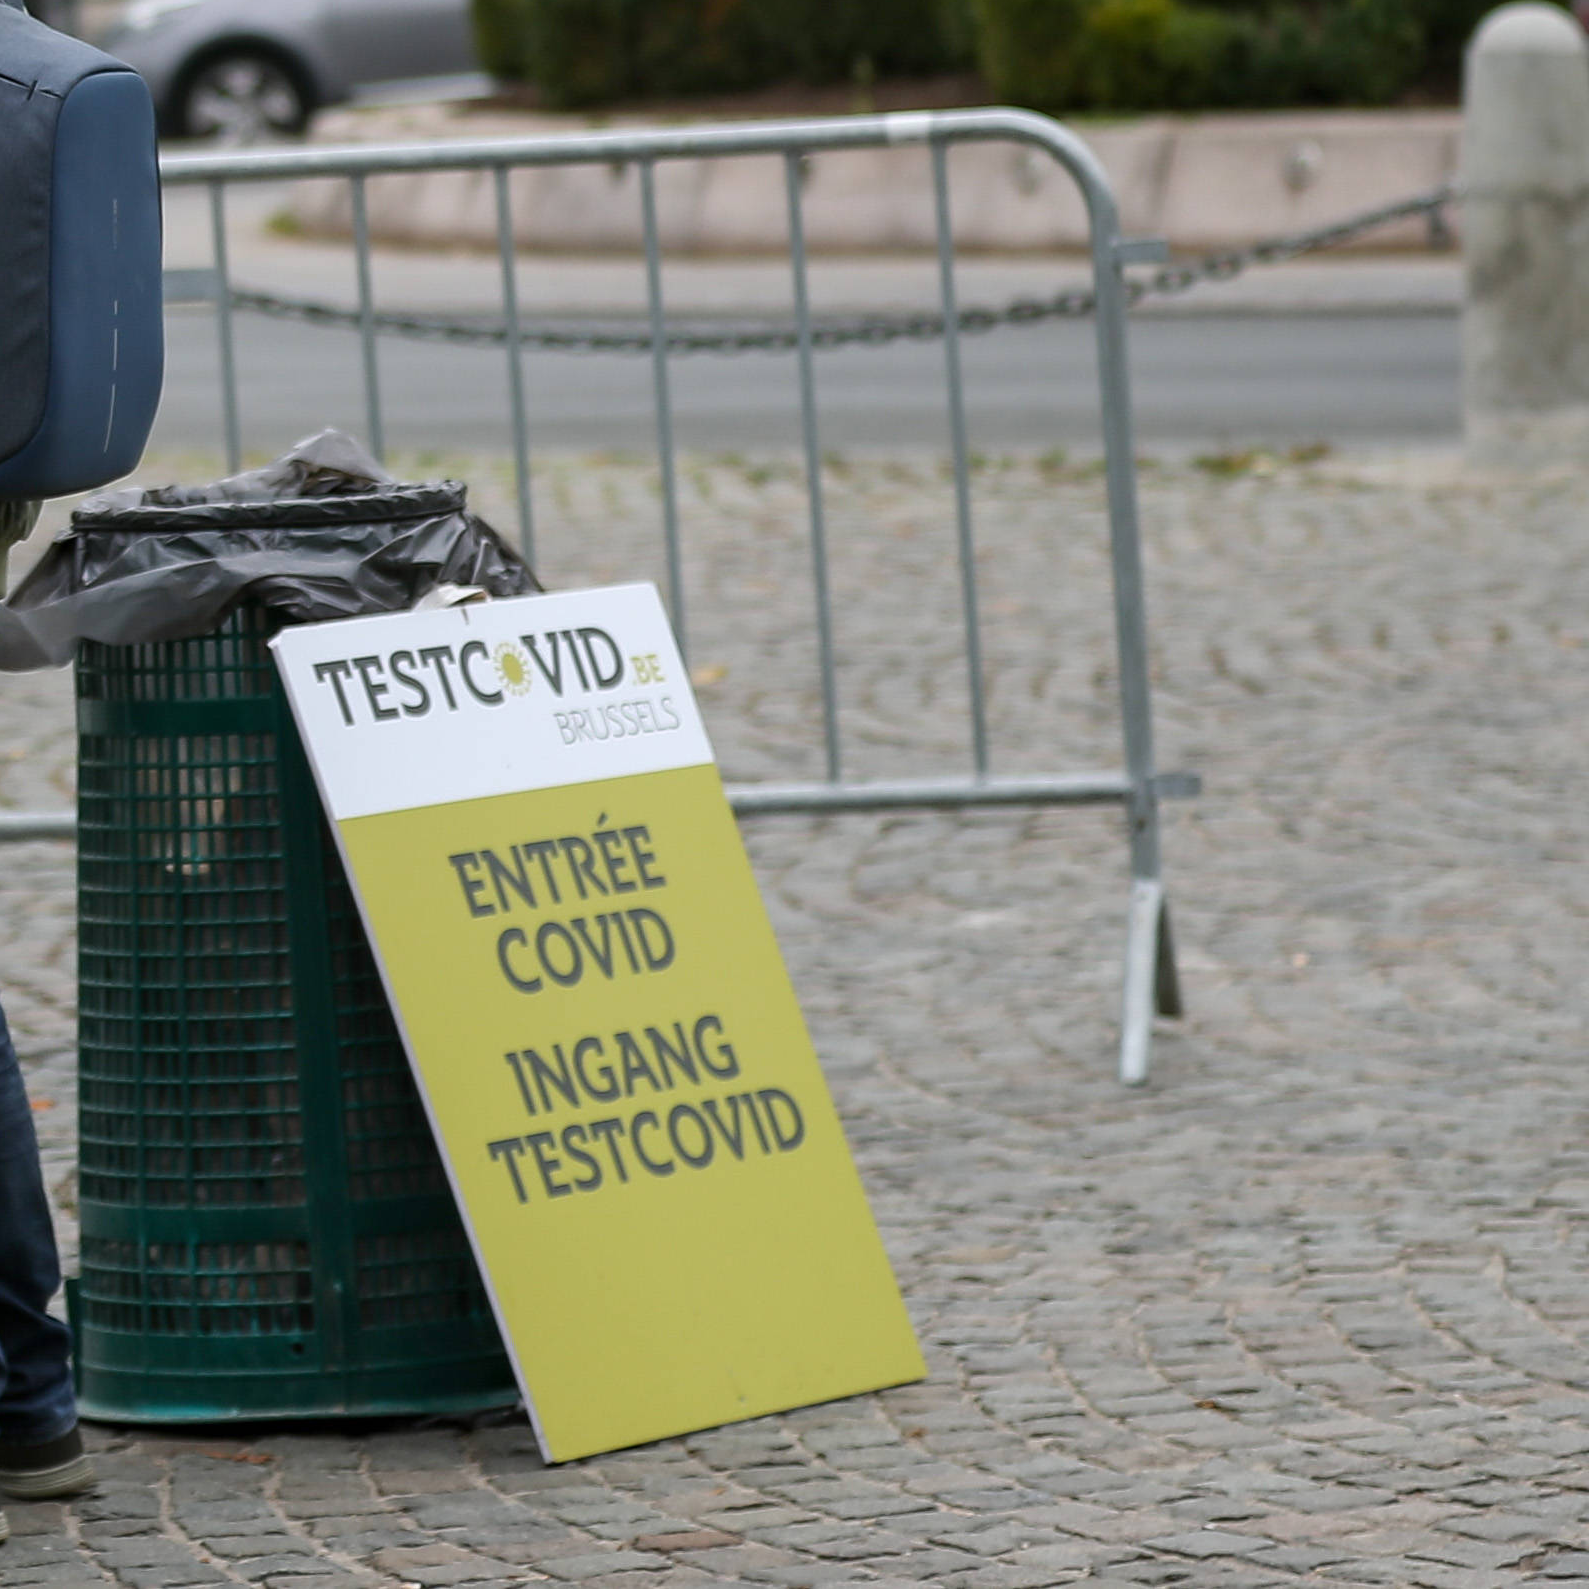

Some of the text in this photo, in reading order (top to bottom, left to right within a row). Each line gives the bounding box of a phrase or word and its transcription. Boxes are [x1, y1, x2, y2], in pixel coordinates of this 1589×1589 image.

[553, 698, 681, 746] BRUSSELS
[448, 813, 667, 918] ENTRÉE
[497, 908, 676, 994] COVID
[505, 1014, 739, 1116] INGANG
[488, 1088, 805, 1203] TESTCOVID
